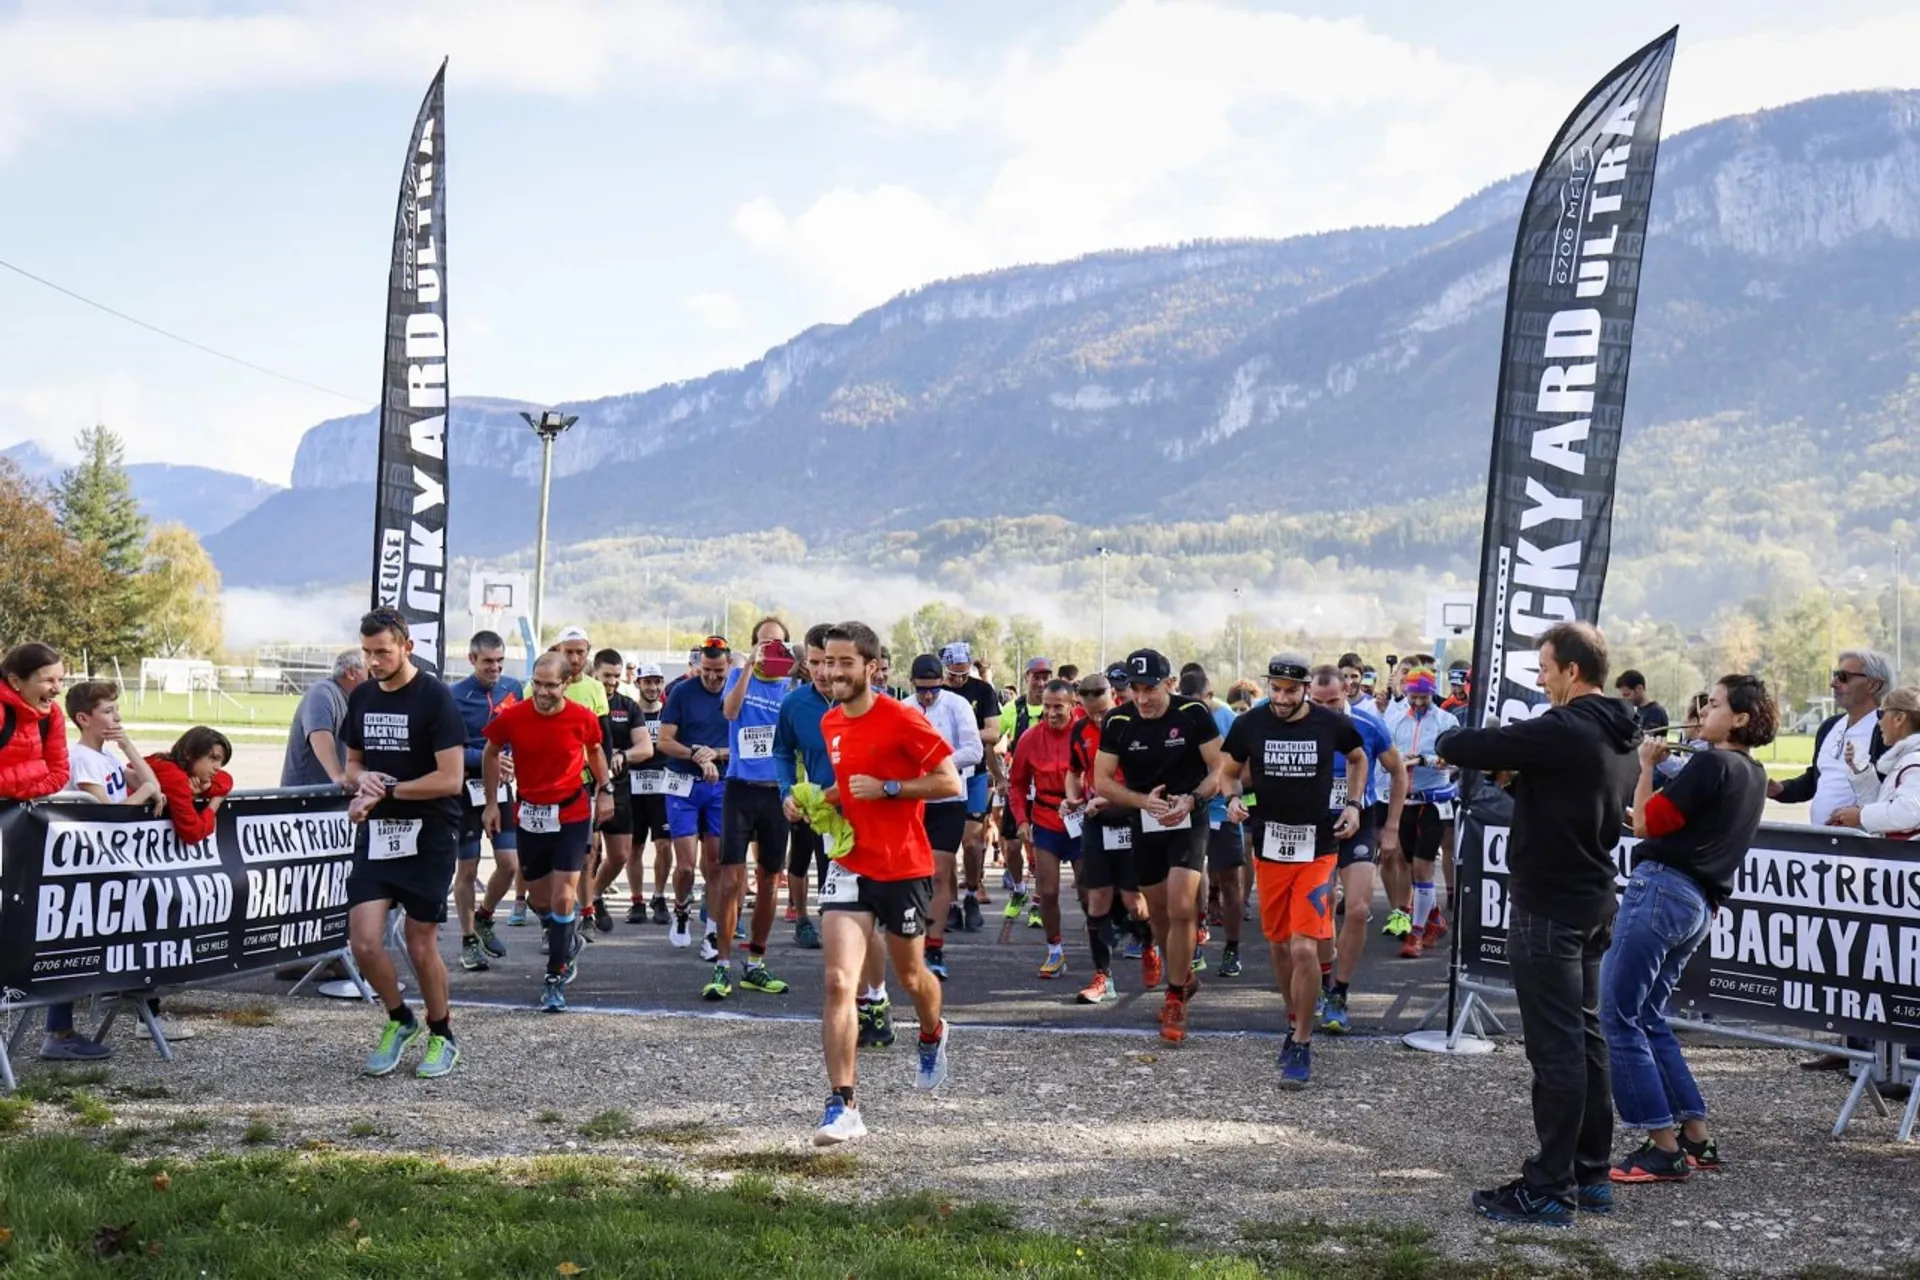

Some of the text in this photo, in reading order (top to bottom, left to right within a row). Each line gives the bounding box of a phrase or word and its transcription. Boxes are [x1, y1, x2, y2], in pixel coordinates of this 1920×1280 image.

[416, 117, 441, 303] ULTRA
[1576, 98, 1640, 298] ULTRA
[1557, 227, 1574, 284] 6706
[405, 312, 446, 672] ACKYARD
[753, 743, 767, 753] 23
[1263, 752, 1318, 765] BACKYARD
[242, 818, 354, 856] CHARTREUSE
[388, 840, 401, 852] 13
[1278, 846, 1296, 856] 48
[35, 871, 234, 942] BACKYARD
[245, 860, 354, 920] BACKYARD
[1737, 858, 1920, 910] HARTREUS
[33, 957, 60, 972] 6706
[63, 955, 101, 968] METER
[106, 938, 194, 974] ULTRA
[210, 939, 229, 951] MILES
[279, 918, 322, 948] ULTRA
[1480, 943, 1501, 954] 6706
[1710, 905, 1920, 988] BACKYAR
[1709, 977, 1736, 990] 6706
[1738, 981, 1778, 997] METER
[1783, 980, 1887, 1024] ULTRA
